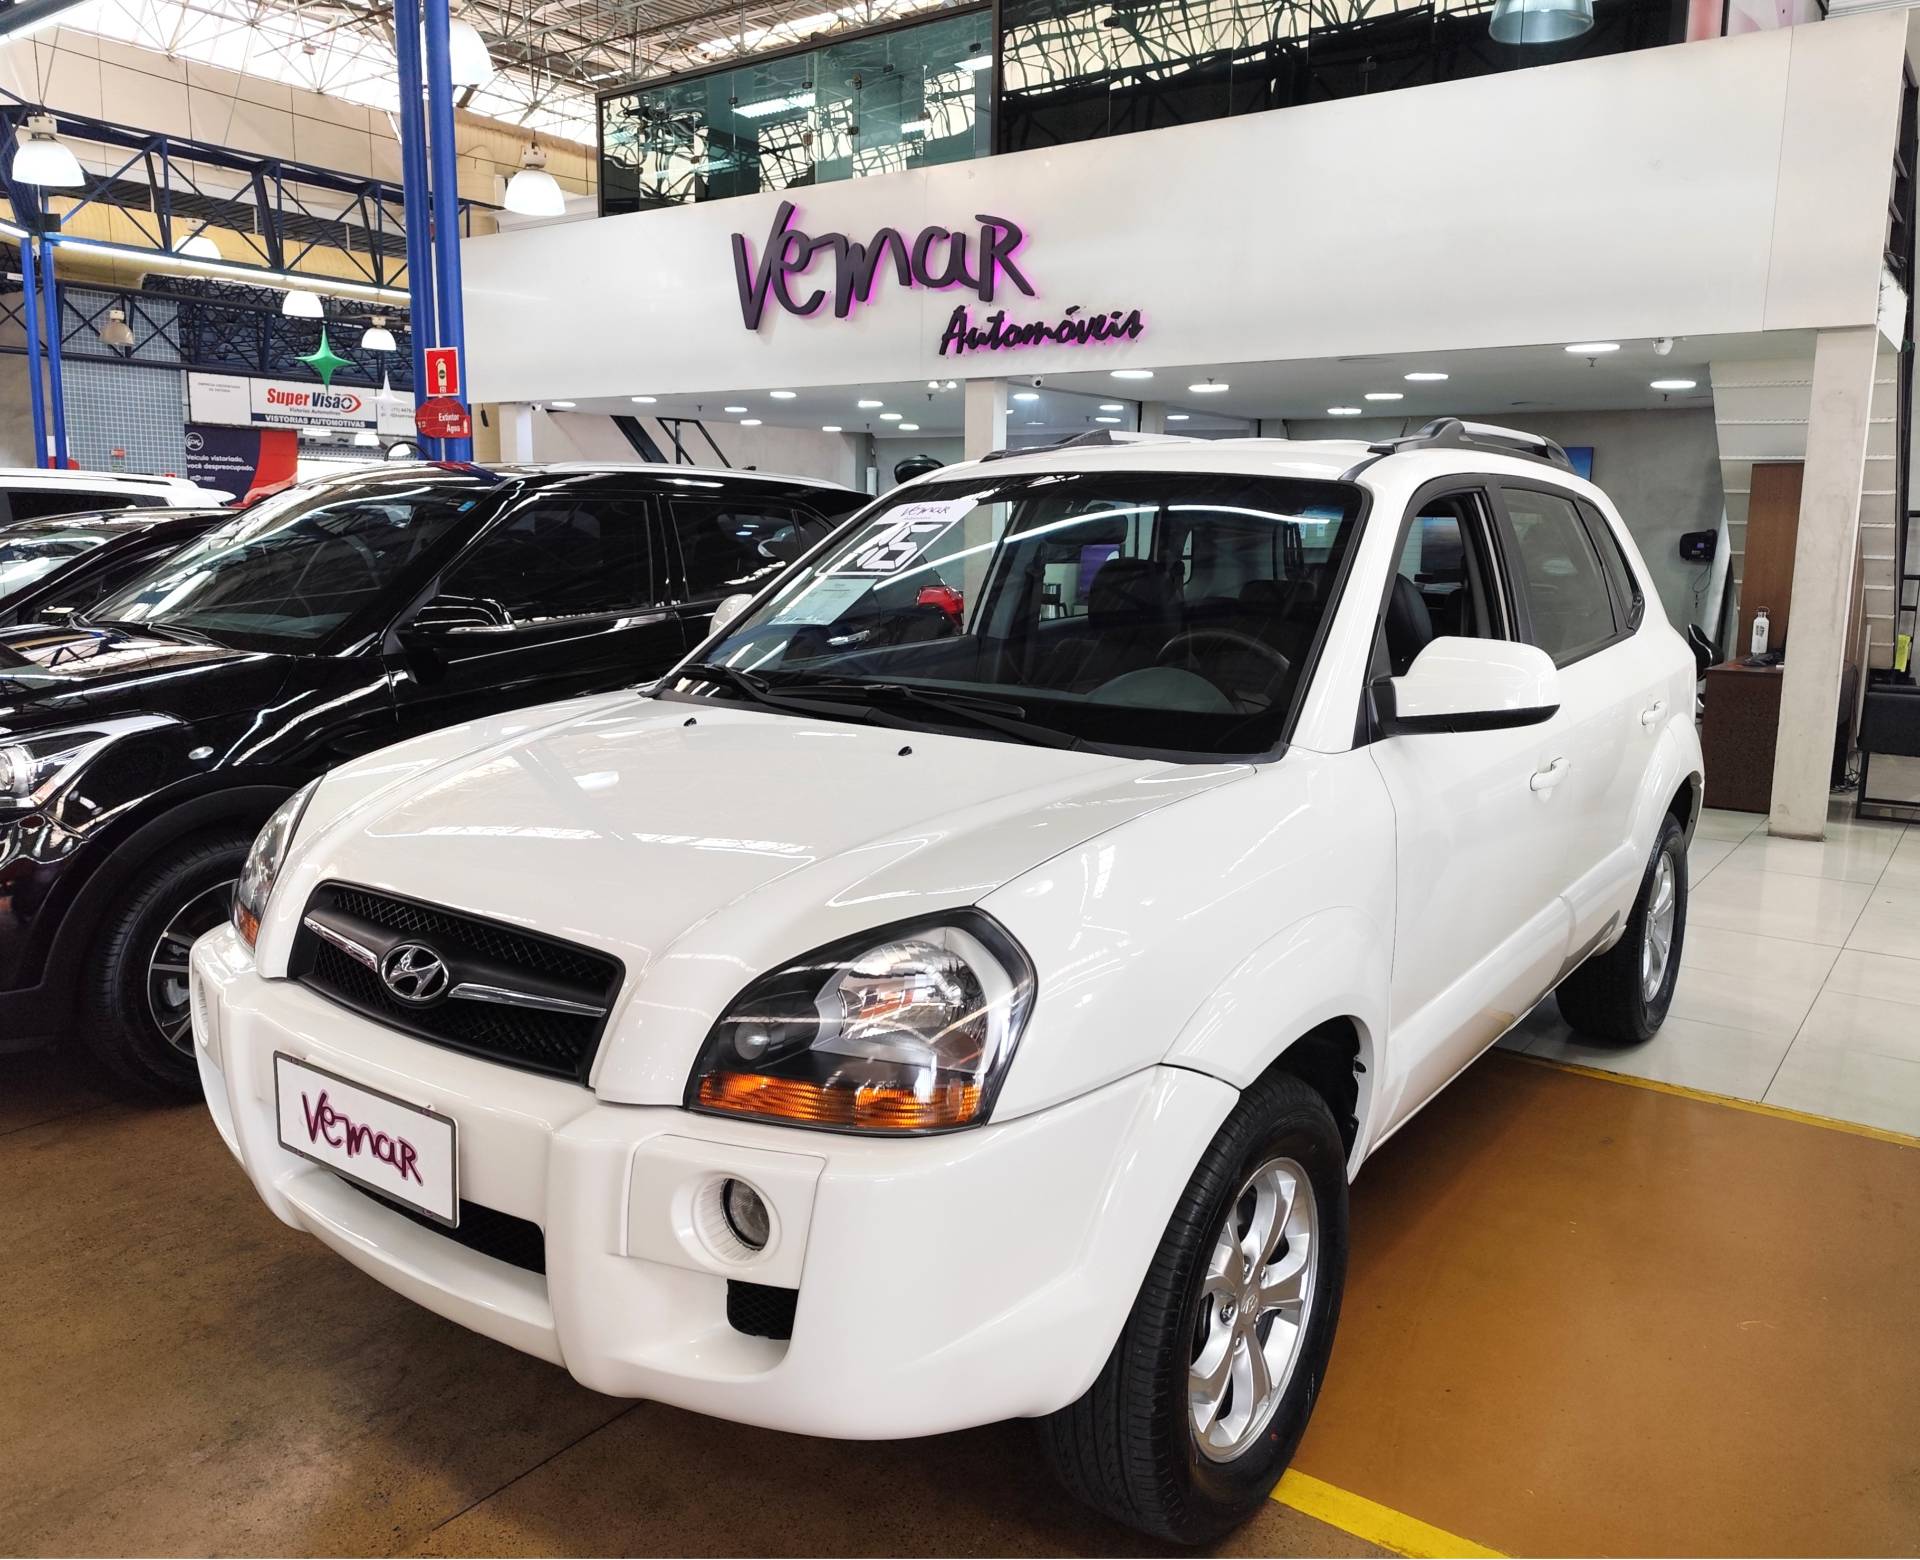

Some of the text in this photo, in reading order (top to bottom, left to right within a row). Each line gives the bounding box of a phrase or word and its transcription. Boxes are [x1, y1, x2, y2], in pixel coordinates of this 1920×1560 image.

[938, 304, 1145, 356] Automóveis
[267, 388, 353, 410] Super Visão
[265, 415, 366, 428] VISTORIAS AUTOMOTIVAS
[438, 412, 460, 422] Extintor
